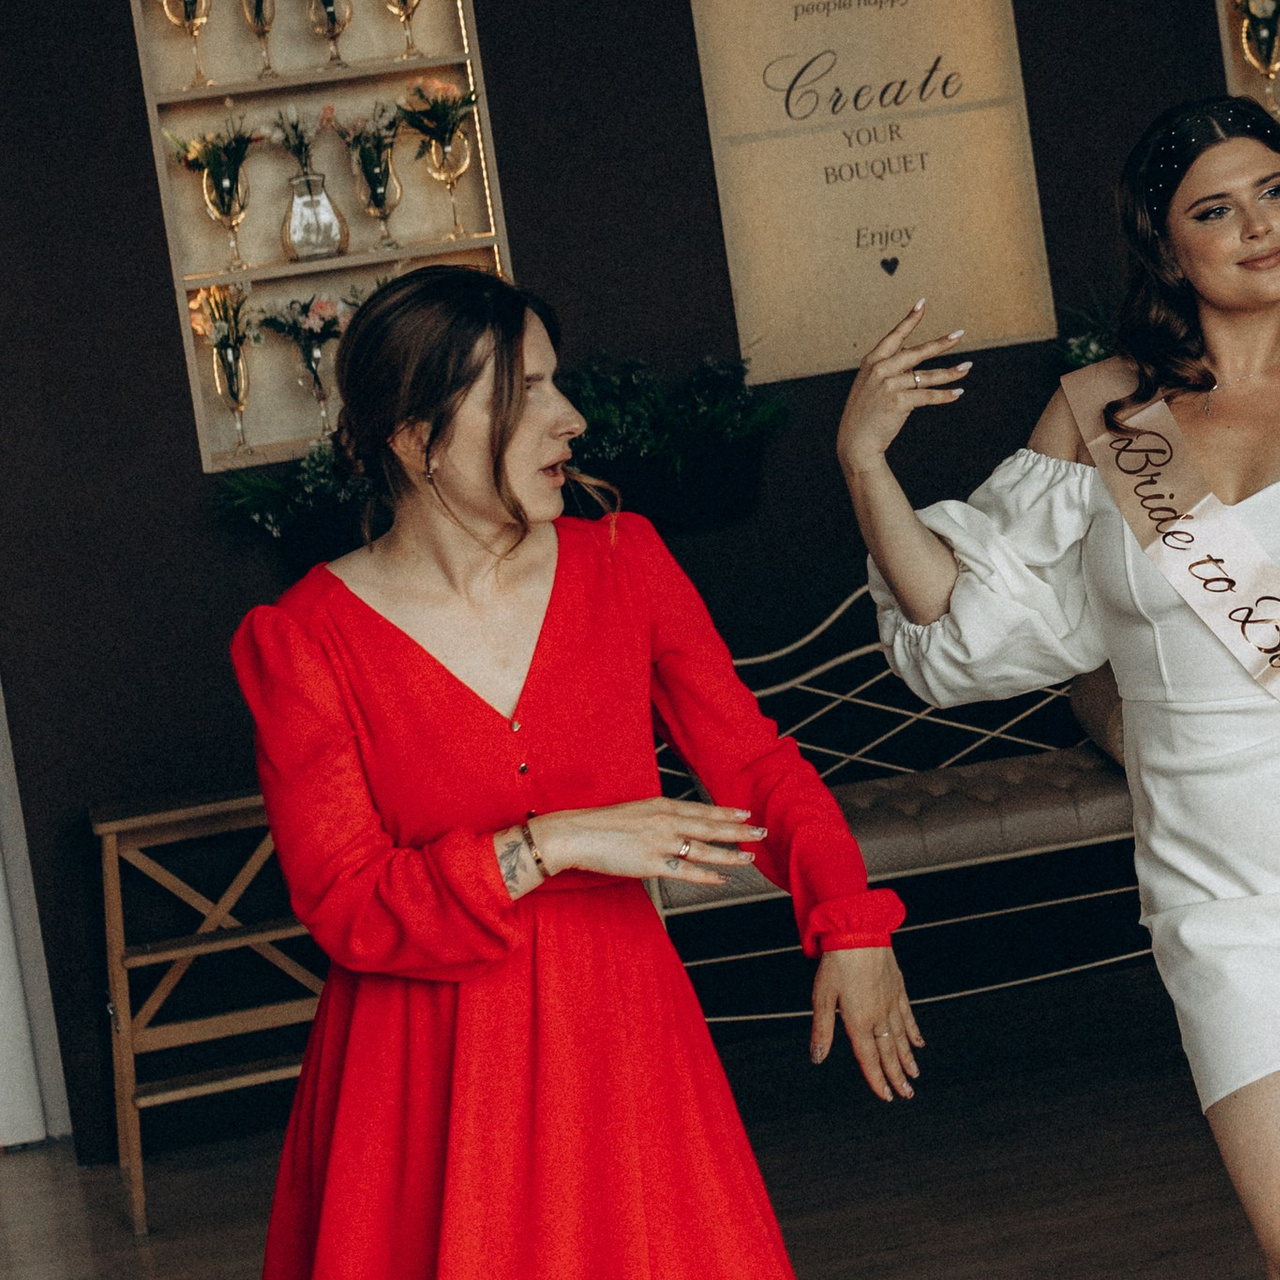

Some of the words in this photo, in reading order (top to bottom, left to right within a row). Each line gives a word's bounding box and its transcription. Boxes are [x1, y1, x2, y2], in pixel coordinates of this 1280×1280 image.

[762, 49, 963, 121] Create
[842, 122, 903, 149] YOUR
[823, 152, 929, 185] BOUQUET
[855, 224, 915, 253] Enjoy
[1108, 430, 1195, 551] Bride
[1187, 553, 1237, 594] to
